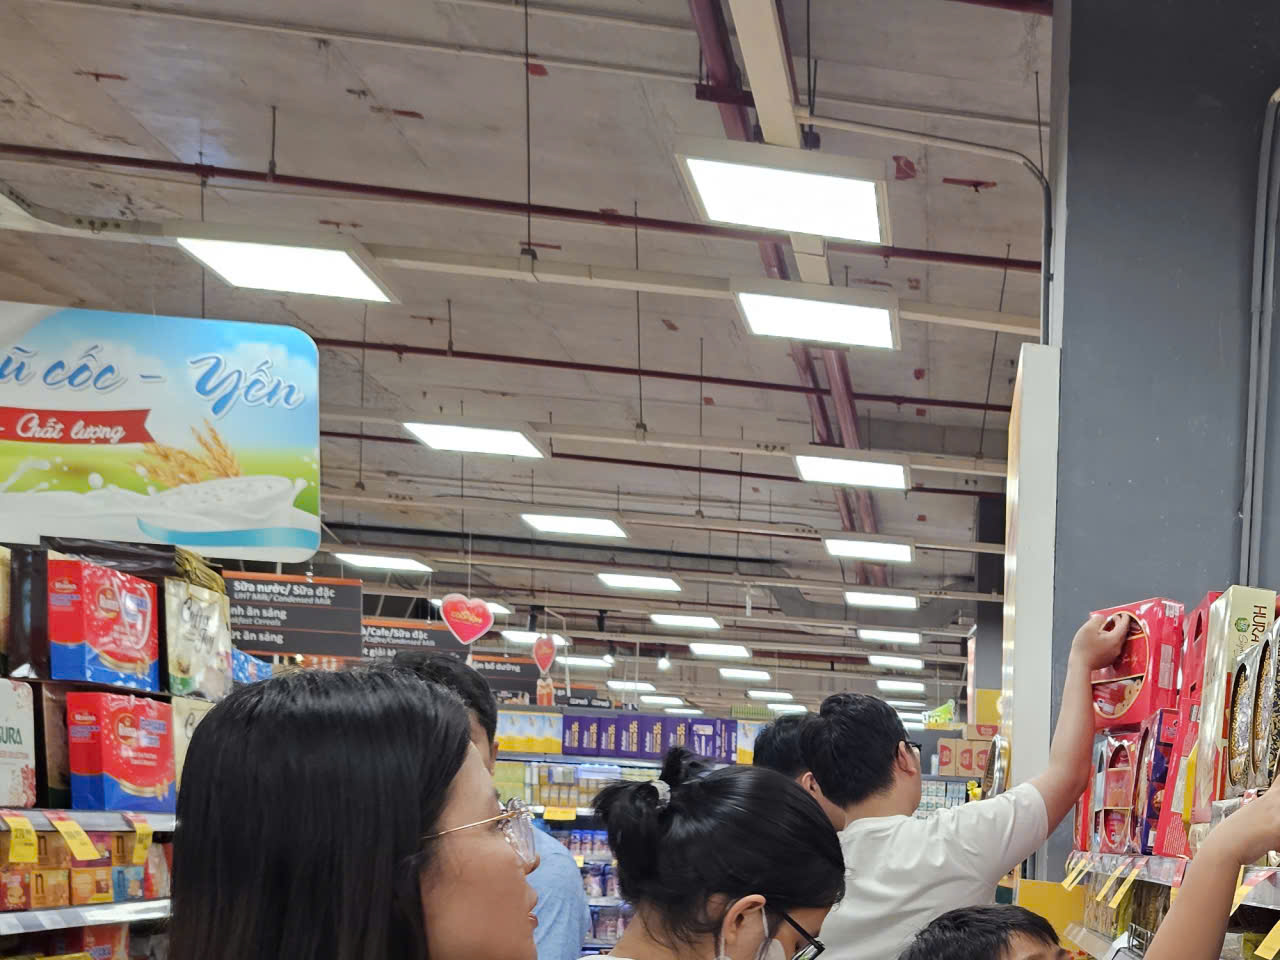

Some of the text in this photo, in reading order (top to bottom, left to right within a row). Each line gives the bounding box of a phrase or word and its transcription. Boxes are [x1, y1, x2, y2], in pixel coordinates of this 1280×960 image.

[42, 345, 121, 391] cốc
[189, 356, 300, 417] Yến
[15, 412, 126, 444] Chất lượng
[234, 580, 336, 598] Sữa nước/ Sữa đặc
[231, 605, 245, 616] nh
[261, 606, 287, 620] sáng
[1250, 604, 1268, 643] HURA
